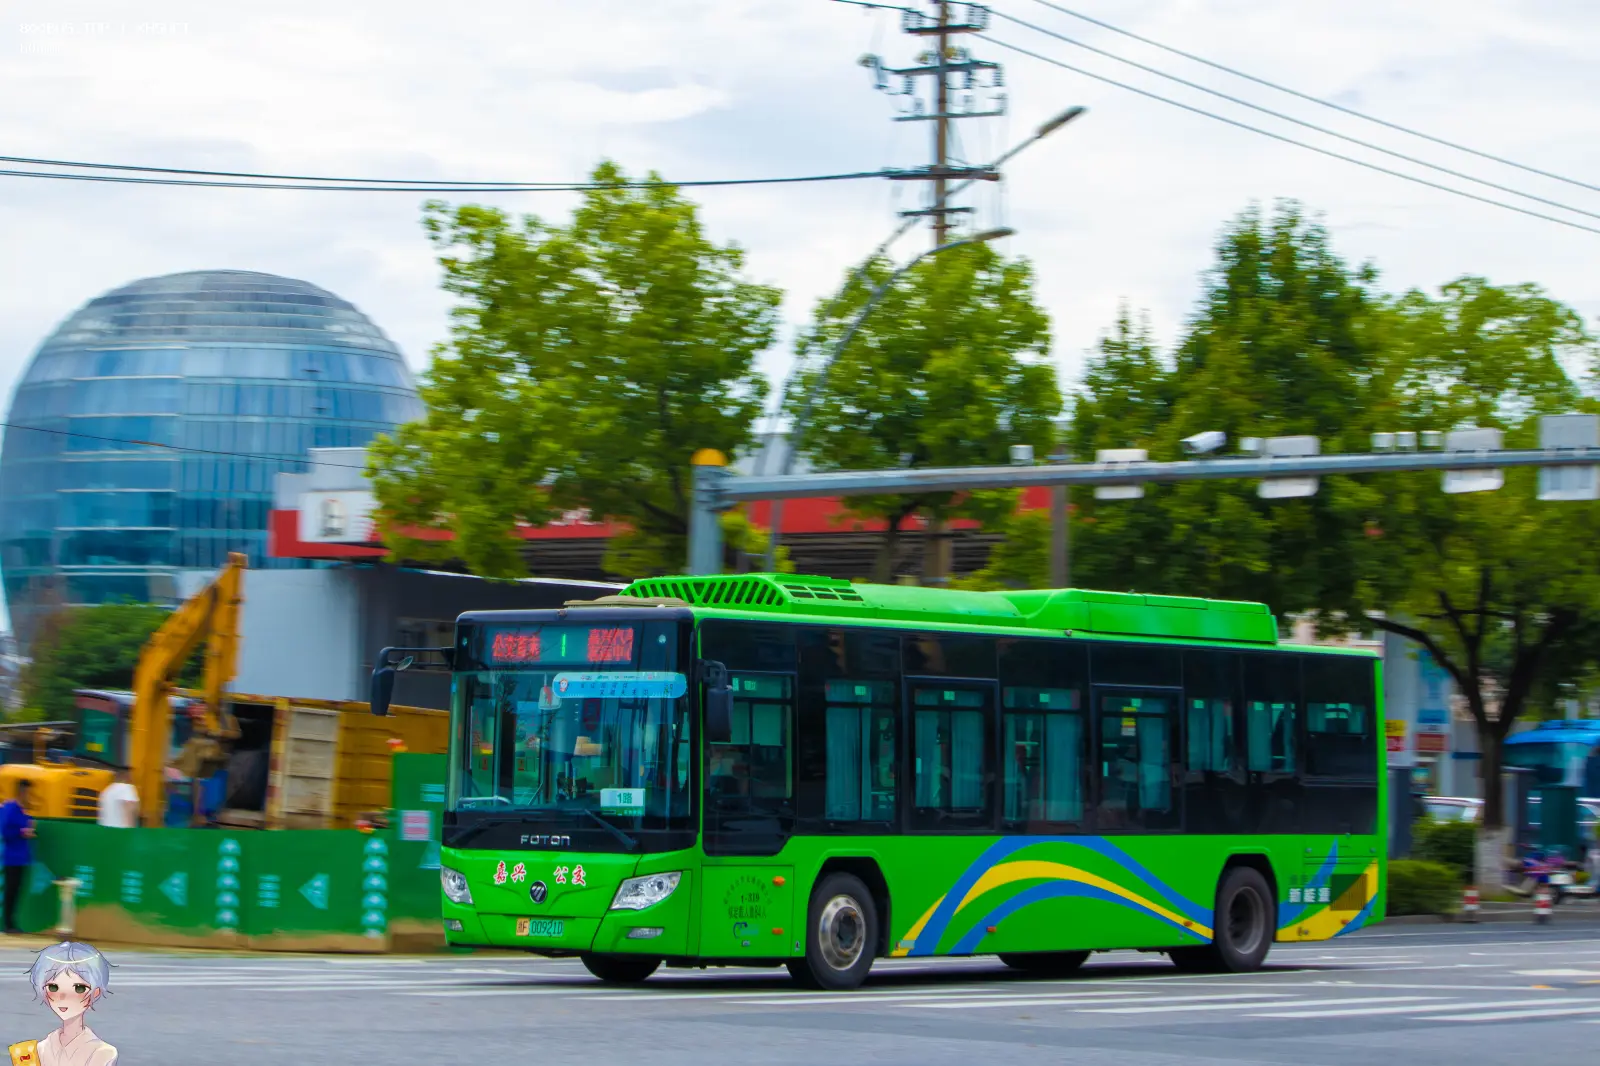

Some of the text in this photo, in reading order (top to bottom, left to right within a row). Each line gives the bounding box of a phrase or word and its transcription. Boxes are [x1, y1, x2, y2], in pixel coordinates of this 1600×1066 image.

[617, 792, 633, 804] 1路
[520, 834, 571, 846] FOTON
[493, 861, 586, 886] 嘉兴 公交
